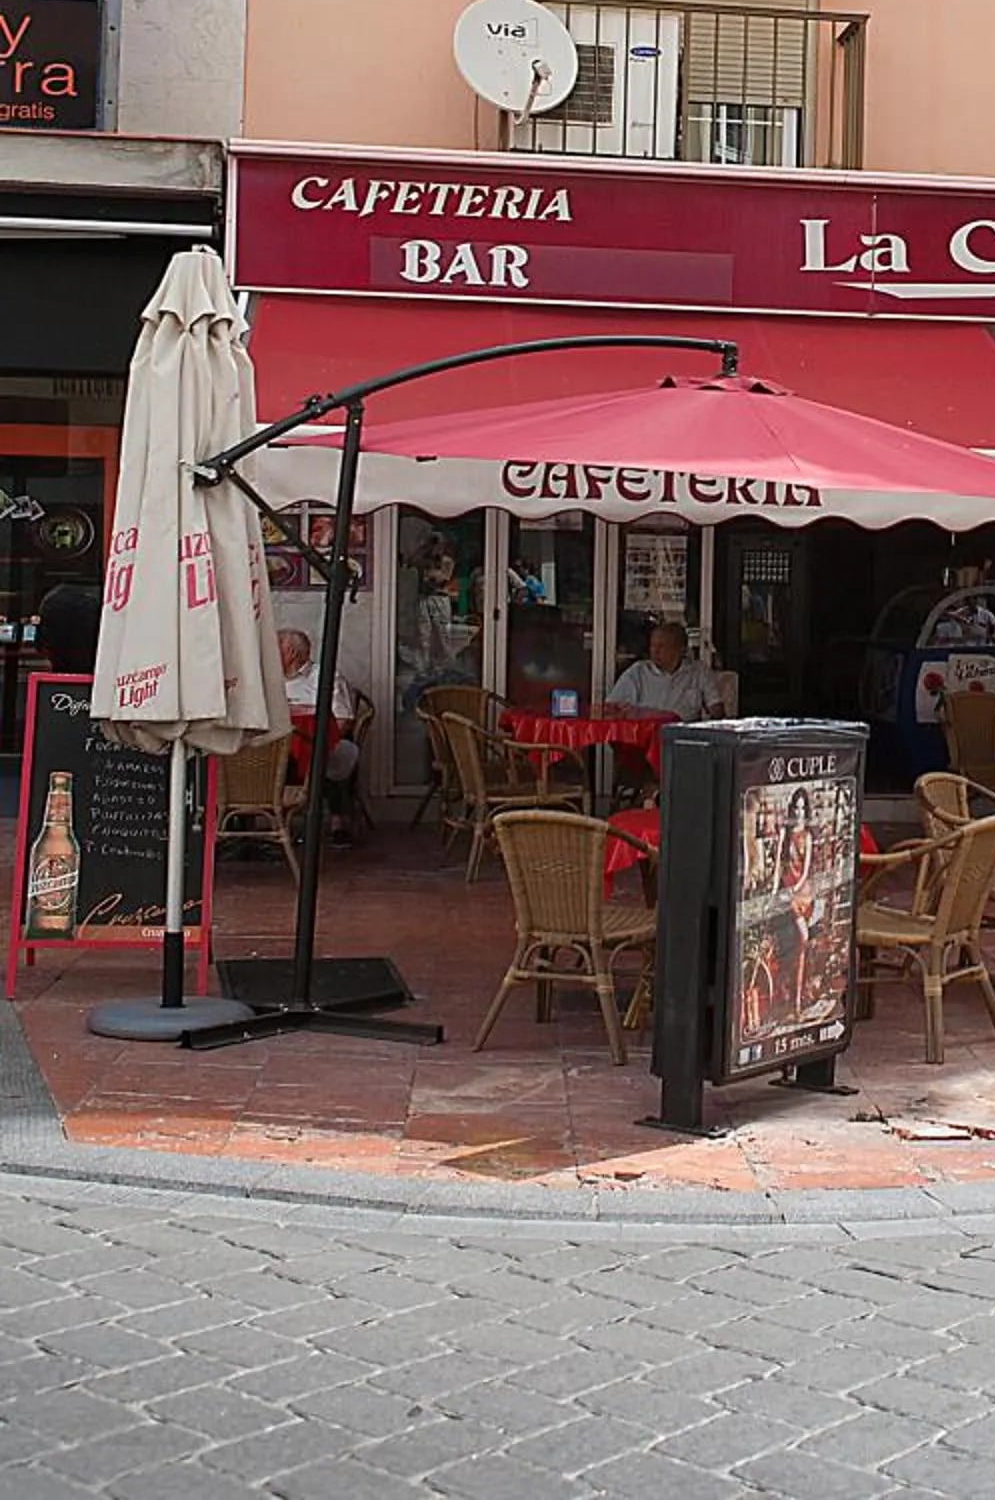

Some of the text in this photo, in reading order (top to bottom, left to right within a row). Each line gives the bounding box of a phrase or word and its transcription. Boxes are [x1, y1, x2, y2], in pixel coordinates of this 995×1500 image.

[0, 102, 55, 121] gratis
[291, 177, 574, 223] CAFETERIA
[399, 239, 531, 289] BAR
[799, 218, 910, 274] La
[118, 680, 159, 709] Light
